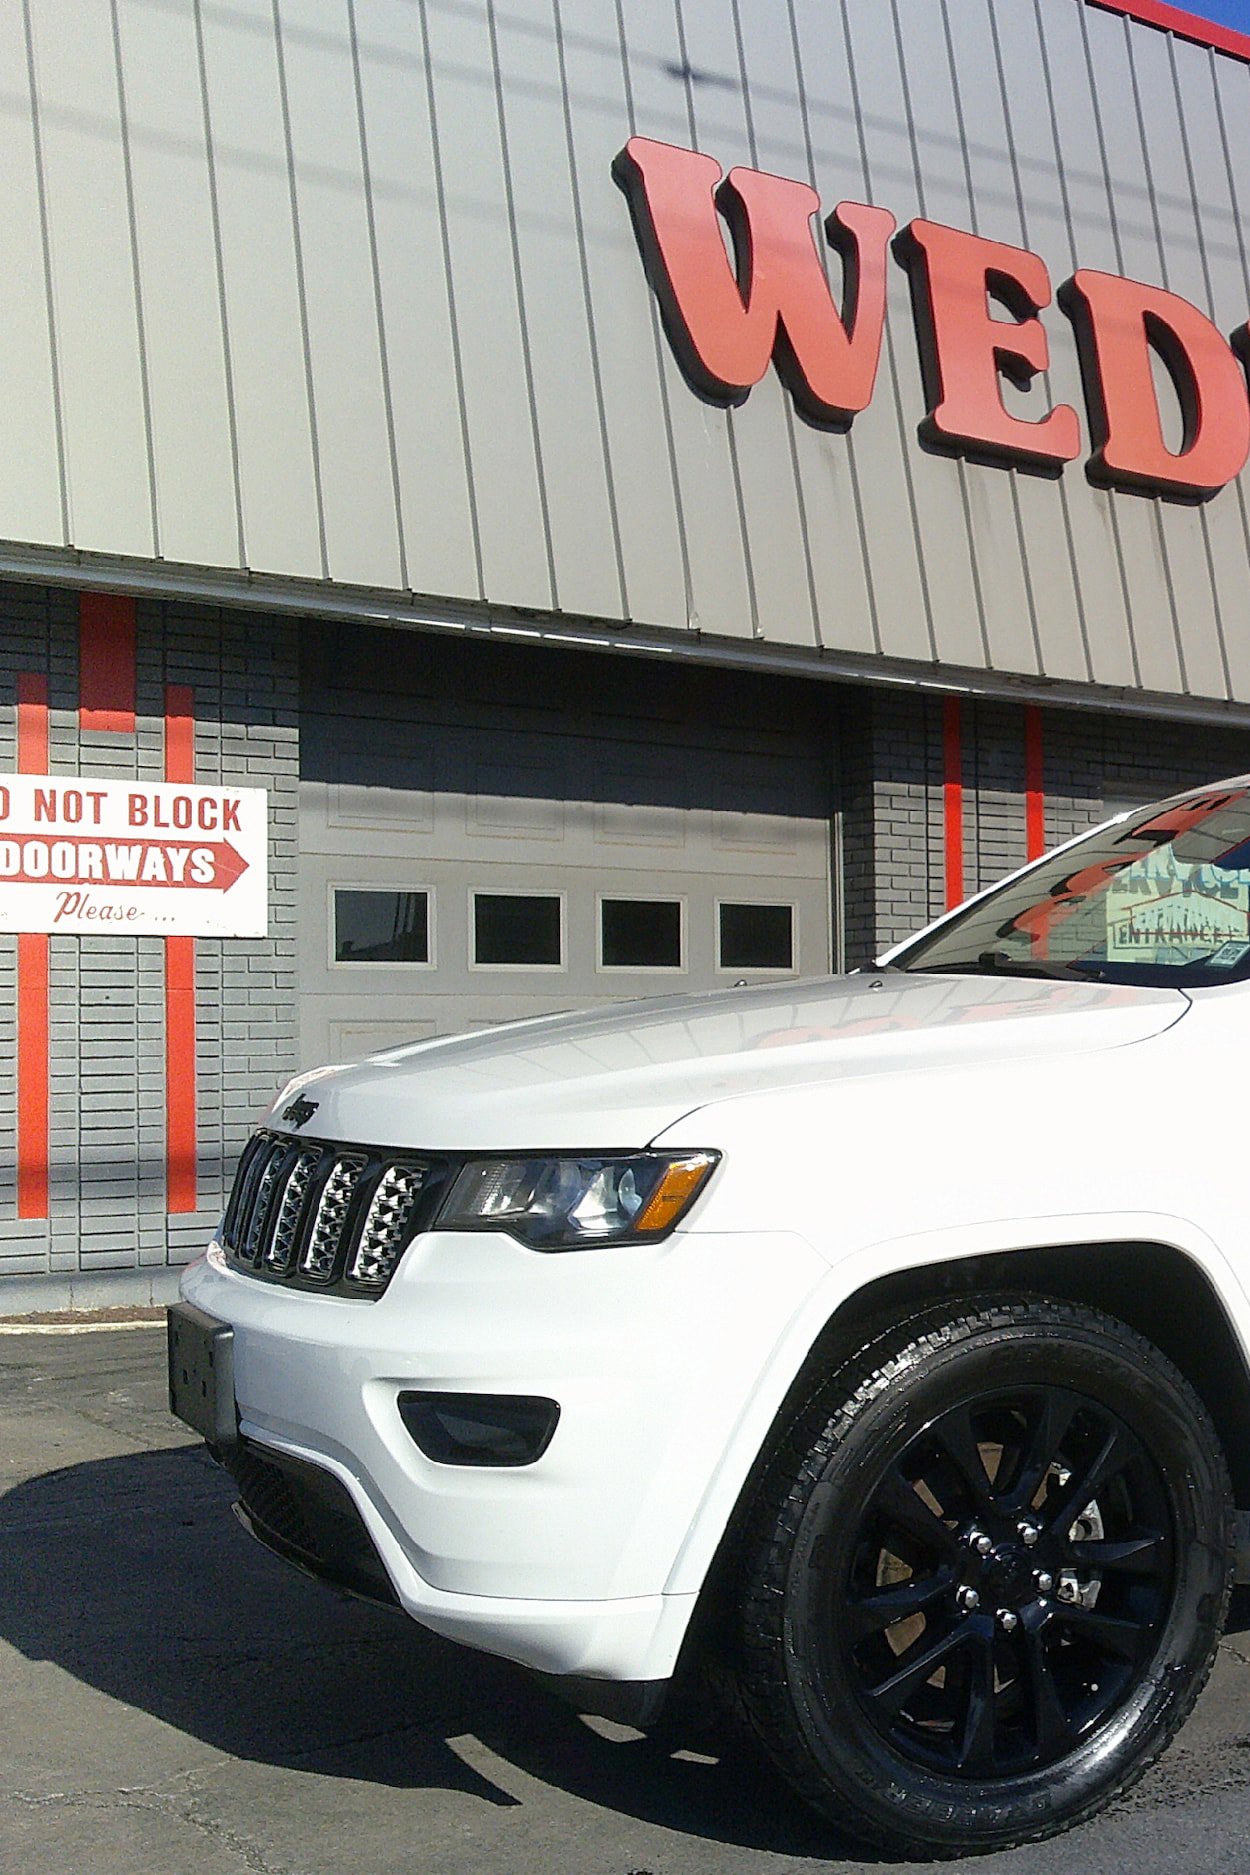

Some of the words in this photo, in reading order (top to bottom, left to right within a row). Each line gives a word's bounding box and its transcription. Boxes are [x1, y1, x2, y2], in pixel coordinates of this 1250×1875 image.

[34, 788, 108, 824] NOT
[128, 793, 242, 832] BLOCK
[0, 840, 216, 884] DOORWAYS
[54, 891, 145, 923] Please
